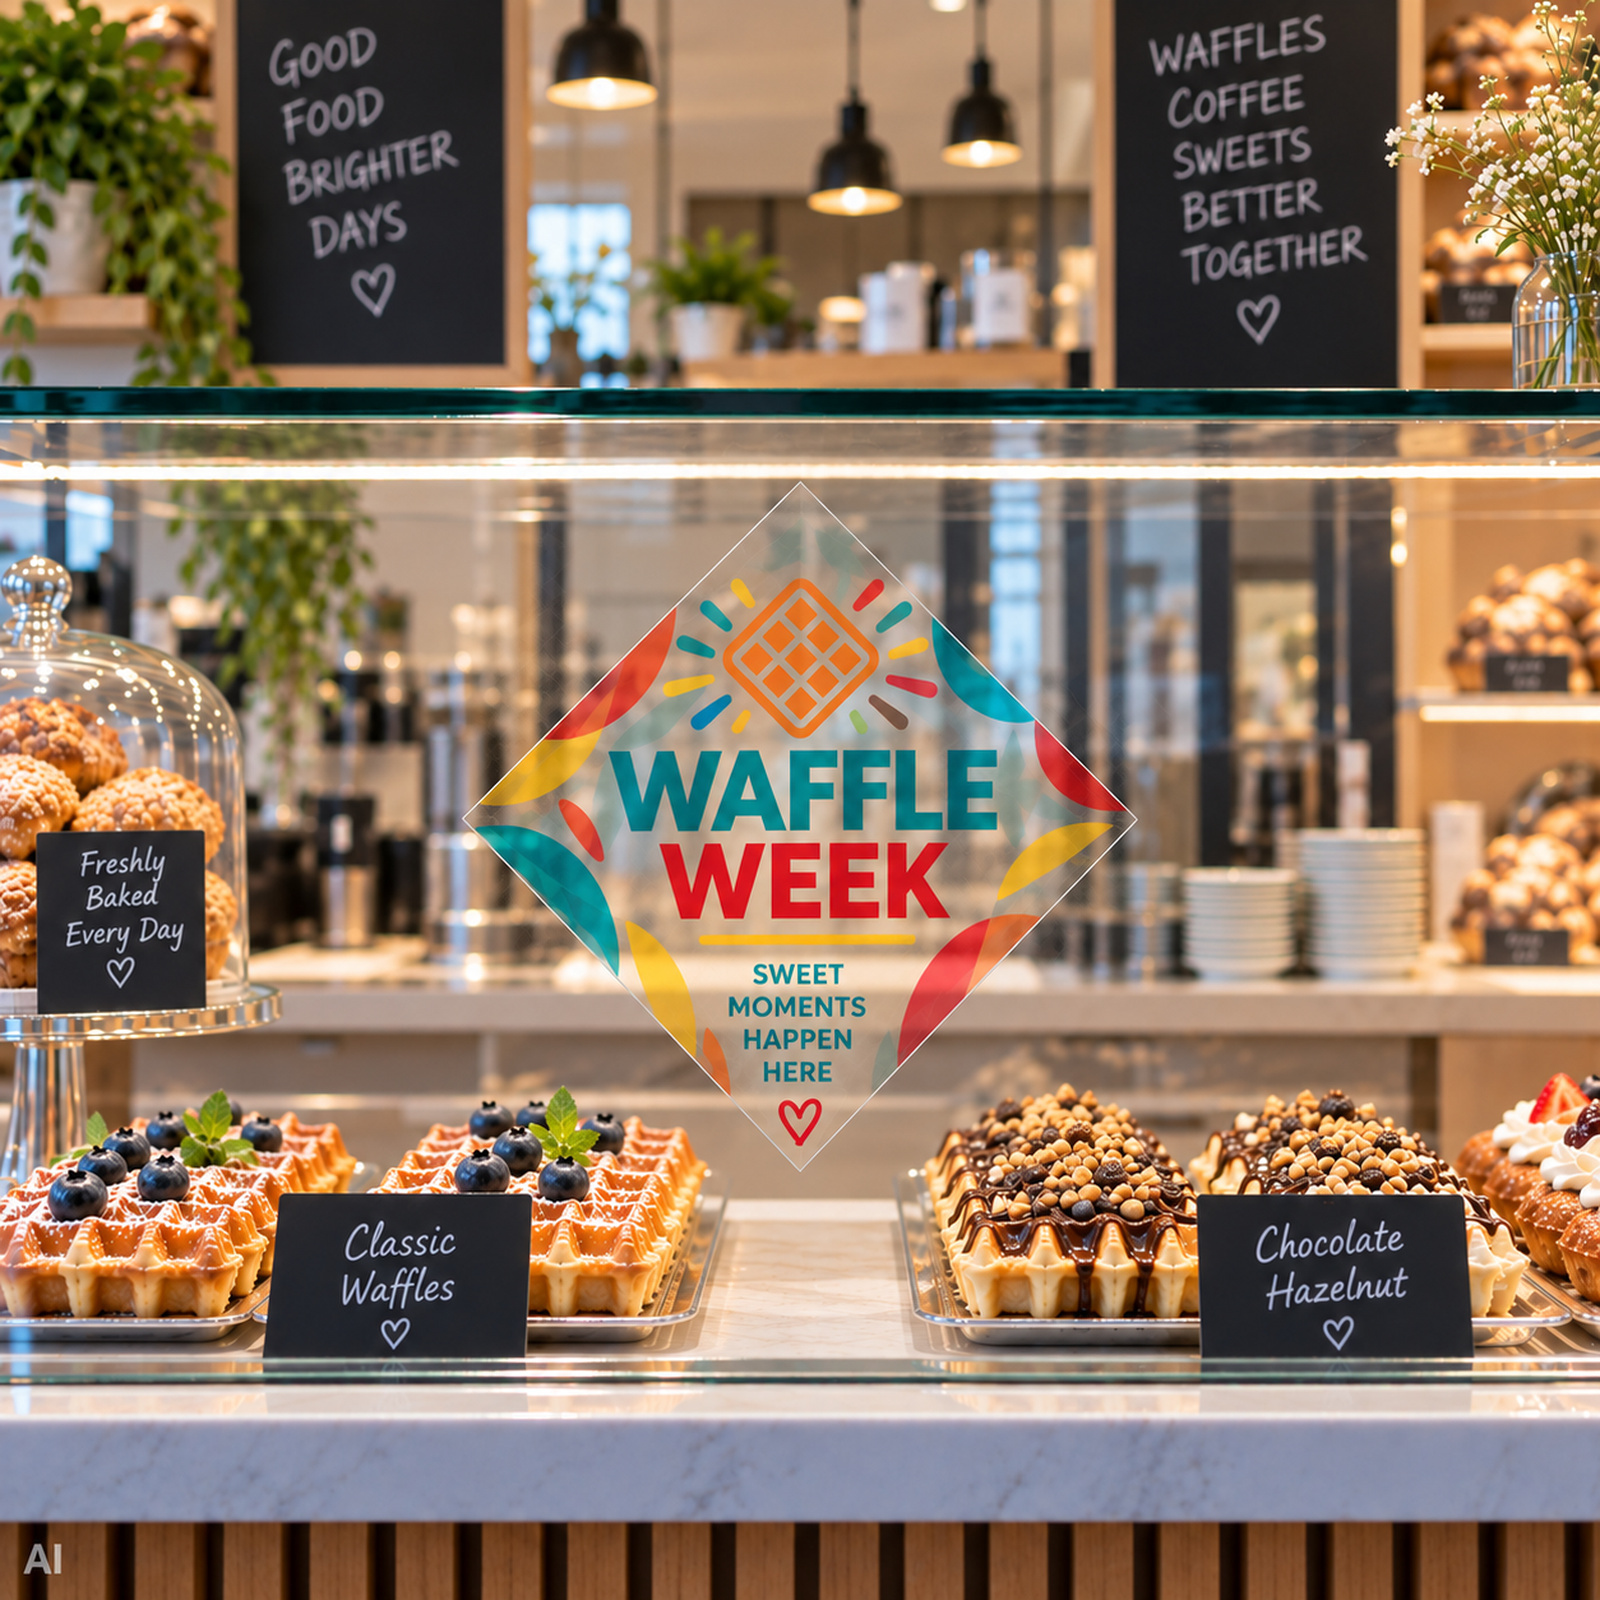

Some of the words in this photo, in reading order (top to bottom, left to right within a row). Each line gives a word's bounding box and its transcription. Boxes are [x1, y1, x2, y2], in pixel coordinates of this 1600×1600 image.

[269, 27, 377, 88] GOOD
[1149, 14, 1327, 76] WAFFLES
[281, 86, 385, 145] FOOD
[1167, 74, 1306, 128] COFFEE
[282, 130, 460, 205] BRIGHTER
[1173, 126, 1312, 179] SWEETS
[308, 201, 408, 259] DAYS
[1180, 177, 1323, 233] BETTER
[1180, 225, 1369, 285] TOGETHER
[608, 749, 998, 832] WAFFLE
[80, 846, 166, 882] Freshly
[659, 842, 951, 919] WEEK
[86, 882, 158, 911] Baked
[66, 921, 130, 954] Every
[139, 916, 185, 952] Day
[752, 963, 845, 985] SWEET
[728, 996, 866, 1019] MOMENTS
[743, 1028, 852, 1051] HAPPEN
[763, 1061, 833, 1083] HERE
[345, 1220, 457, 1261] Classic
[1255, 1217, 1405, 1265] Chocolate
[341, 1266, 455, 1310] Waffles
[1266, 1265, 1410, 1311] Hazelnut
